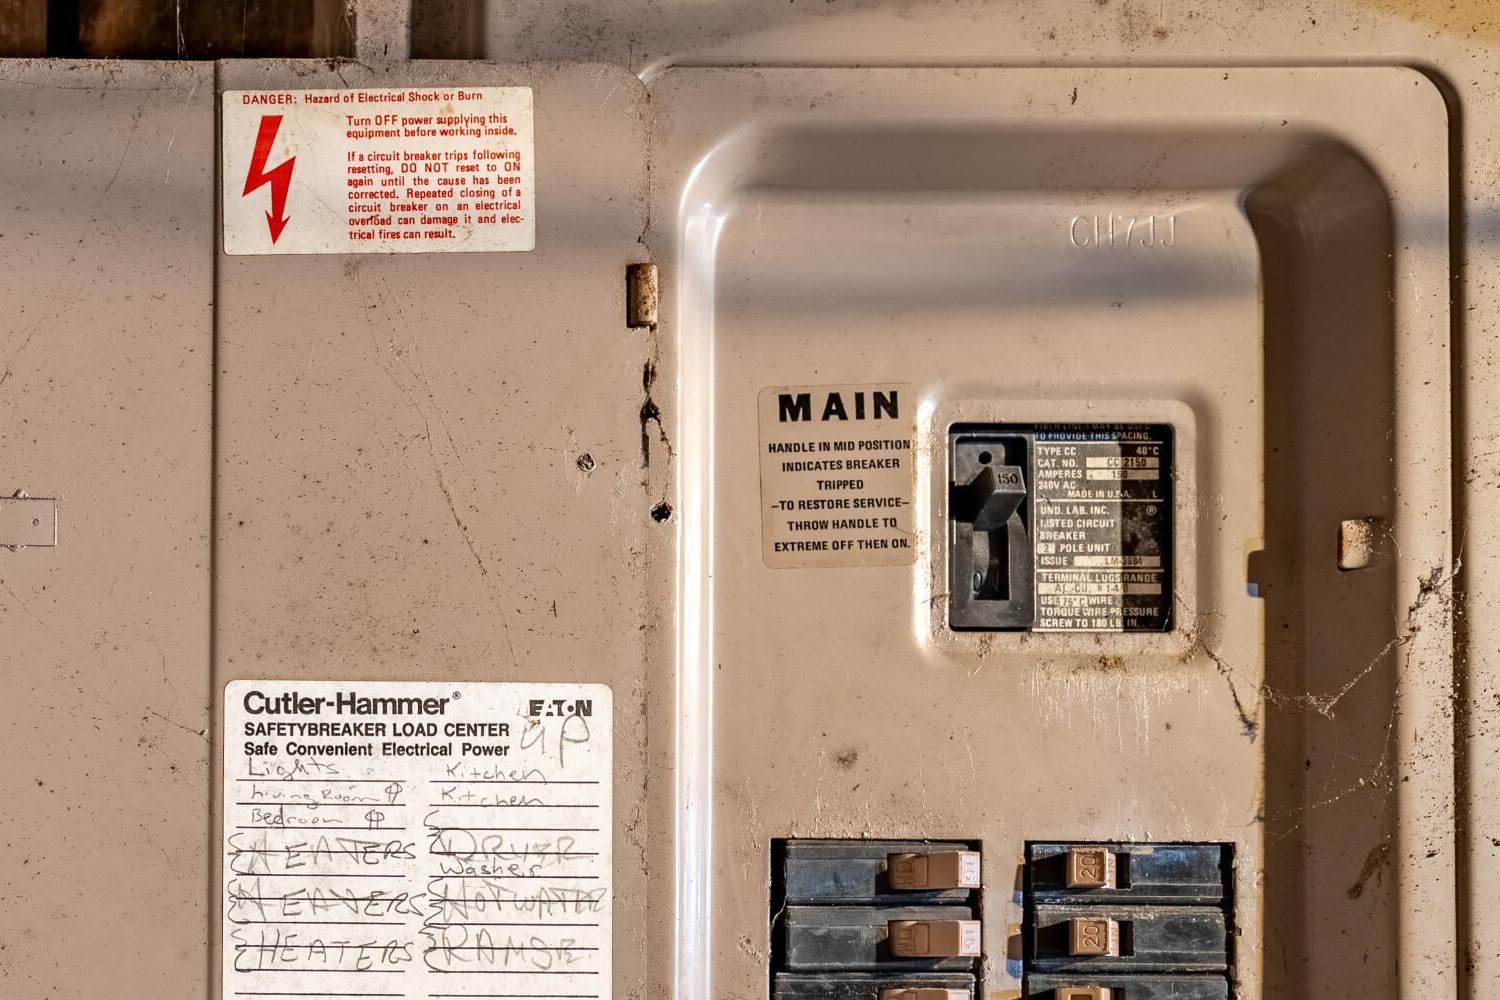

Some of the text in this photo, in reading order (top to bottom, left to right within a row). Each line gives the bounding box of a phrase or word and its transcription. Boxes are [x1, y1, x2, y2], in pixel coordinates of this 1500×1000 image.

[242, 92, 483, 104] DANGER: Hazard of Electrical Shock or Burn
[346, 113, 507, 127] Turn OFF power supplying this
[347, 126, 517, 139] equipment before working inside.
[348, 150, 520, 161] If a circuit breaker trips following
[348, 162, 520, 175] resetting, DO NOT reset to ON
[348, 175, 520, 188] again until the cause has been
[348, 187, 521, 200] corrected. Repeated closing of a
[349, 201, 521, 212] circuit breaker on an electrical
[349, 213, 524, 226] overload can damage it and elec-
[349, 229, 455, 240] trical fires can result.
[779, 391, 898, 422] MAIN
[768, 440, 911, 453] HANDLE IN MID POSITION
[1037, 446, 1076, 455] TYPE CC
[782, 459, 900, 472] INDICATES BREAKER
[998, 474, 1018, 484] 150
[1038, 470, 1082, 478] AMPERES
[817, 480, 863, 490] TRIPPED
[799, 499, 849, 510] RESTORE
[788, 518, 897, 531] THROW HANDLE TO
[1040, 531, 1085, 540] BREAKER
[775, 538, 910, 552] EXTREME OFF THEN ON.
[244, 723, 510, 737] SAFETYBREAKER LOAD CENTER
[244, 742, 510, 756] Safe Convenient Electrical Power
[249, 757, 339, 780] Lights
[447, 762, 547, 785] Kitchen
[442, 787, 543, 807] Kitchen
[252, 804, 342, 827] Bedroom
[440, 857, 541, 877] Washer
[1081, 855, 1096, 878] 20
[1084, 926, 1099, 947] 20
